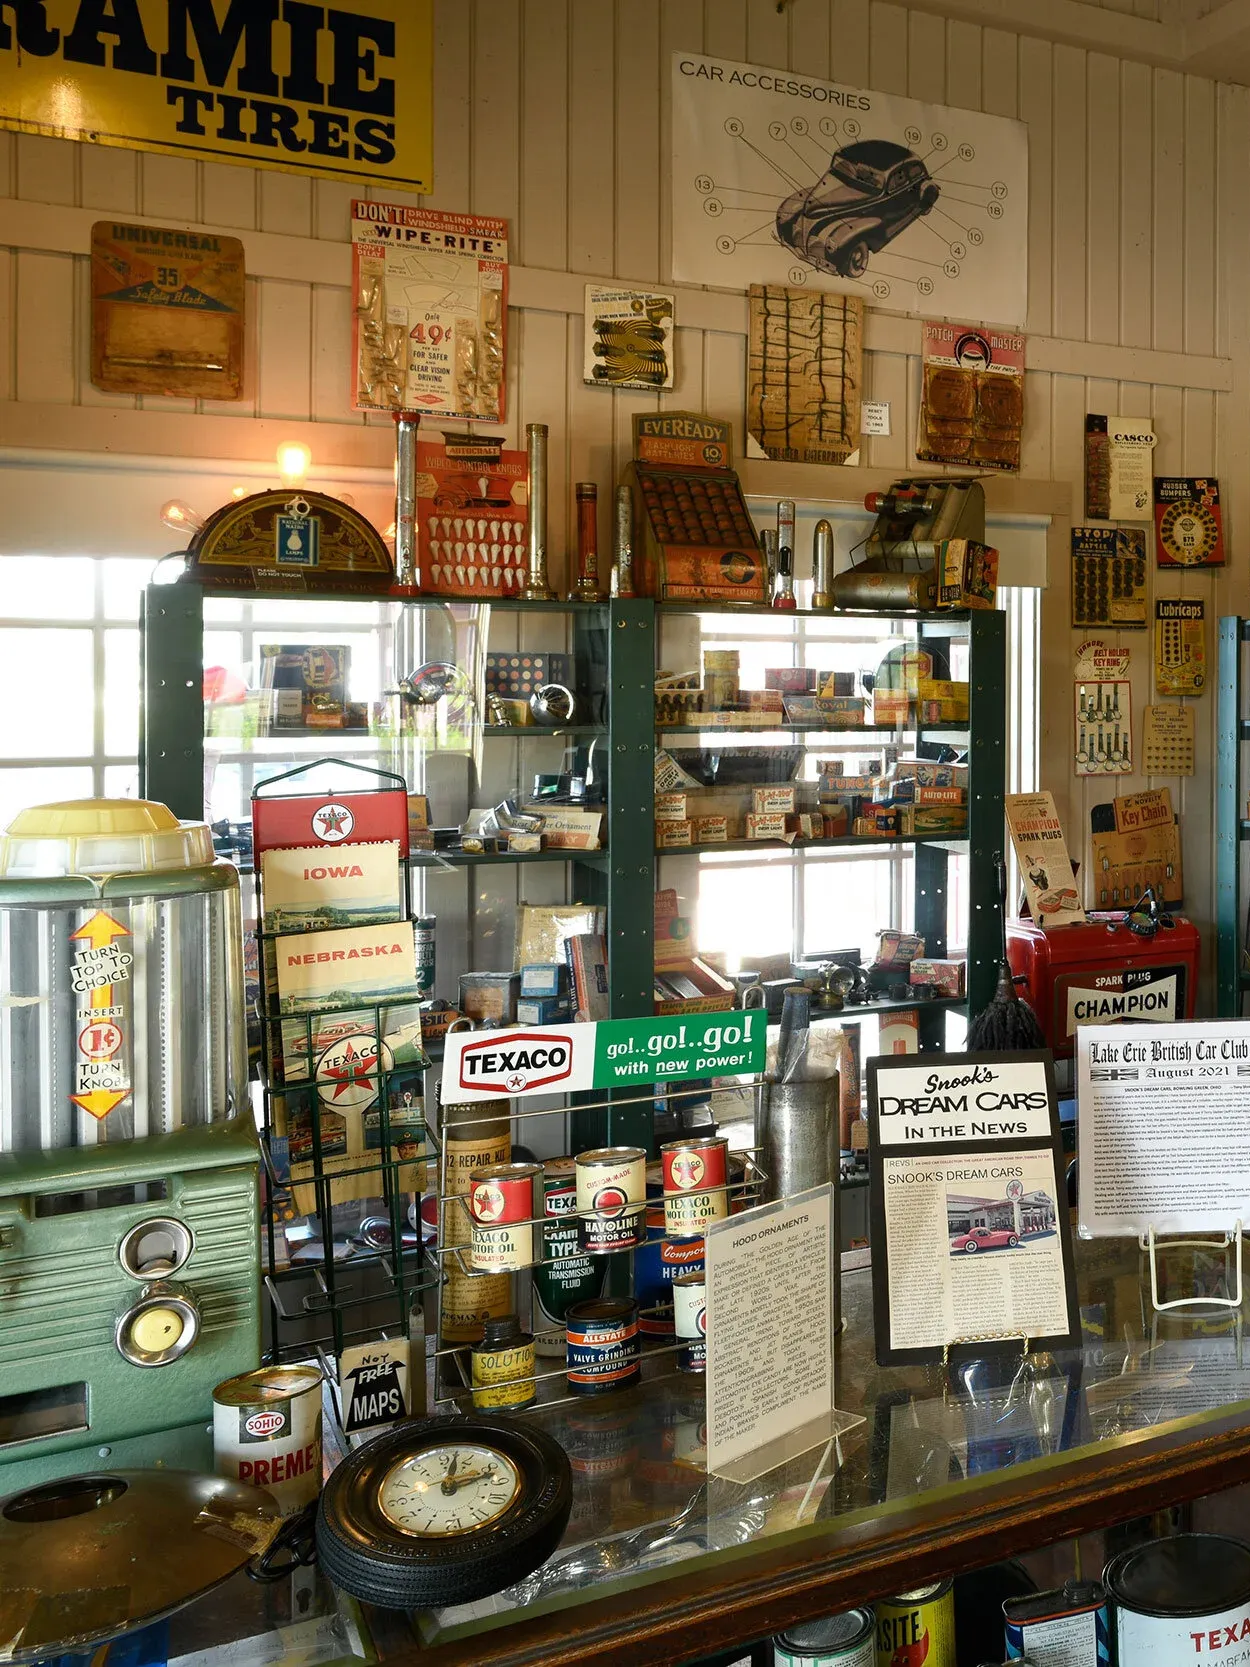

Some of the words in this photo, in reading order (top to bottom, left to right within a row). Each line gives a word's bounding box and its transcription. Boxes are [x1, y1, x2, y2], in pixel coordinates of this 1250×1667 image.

[680, 61, 724, 82] CAR
[729, 71, 871, 111] ACCESSORIES
[167, 85, 396, 164] TIRES
[357, 202, 407, 224] DON'T!
[408, 209, 438, 221] DRIVE
[443, 215, 473, 226] BLIND
[476, 218, 503, 229] WITH
[408, 219, 466, 233] WINDSHIELD
[468, 228, 504, 239] SMEAR
[112, 224, 221, 252] UNIVERSAL
[375, 225, 494, 253] WIPE-RITE
[157, 267, 178, 287] 35
[926, 327, 954, 342] PATCH
[991, 336, 1022, 351] MASTER
[413, 350, 426, 359] FOR
[428, 352, 448, 361] SAFER
[409, 364, 430, 372] CLEAR
[431, 366, 450, 375] VISION
[417, 374, 442, 383] DRIVING
[643, 419, 724, 440] EVEREADY
[1114, 433, 1154, 443] CASCO
[457, 461, 491, 473] CONTROL
[496, 464, 522, 475] KNOBS
[1159, 602, 1202, 619] Lubricaps
[1093, 658, 1105, 667] KEY
[1107, 658, 1121, 667] RING
[924, 791, 957, 799] AUTO-LITE
[1122, 811, 1139, 827] Key
[1142, 804, 1168, 822] Chain
[1015, 818, 1060, 832] CHAMPION
[1018, 832, 1041, 842] SPARK
[1041, 830, 1062, 840] PLUGS
[304, 864, 363, 881] IOWA
[79, 946, 119, 964] TURN
[288, 943, 403, 966] NEBRASKA
[74, 962, 103, 979] TOP
[110, 954, 131, 967] TO
[75, 969, 128, 992] CHOICE
[1095, 975, 1123, 987] SPARK
[1127, 972, 1151, 983] PLUG
[79, 1006, 122, 1018] INSERT
[1074, 991, 1169, 1019] CHAMPION
[324, 1045, 379, 1068] TEXACO
[1090, 1041, 1119, 1064] Lake
[1122, 1042, 1147, 1063] Erie
[1150, 1039, 1192, 1064] British
[1195, 1040, 1217, 1061] Car
[1220, 1038, 1249, 1060] Club
[80, 1063, 121, 1075] TURN
[465, 1047, 566, 1075] TEXACO
[614, 1061, 648, 1076] with
[656, 1058, 688, 1074] new
[924, 1066, 999, 1094] Snook's
[1145, 1067, 1194, 1080] August
[1198, 1066, 1229, 1077] 2021
[880, 1094, 968, 1117] DREAM
[976, 1091, 1047, 1111] CARS
[929, 1125, 966, 1137] THE
[889, 1159, 911, 1168] REVS
[888, 1171, 943, 1184] SNOOK'S
[946, 1169, 988, 1181] DREAM
[991, 1167, 1023, 1178] CARS
[670, 1197, 710, 1209] TEXACO
[667, 1209, 697, 1219] MOTOR
[701, 1207, 717, 1217] OIL
[585, 1217, 638, 1232] HAVOLINE
[732, 1232, 757, 1249] HOOD
[758, 1214, 809, 1242] ORNAMENTS
[590, 1233, 618, 1241] MOTOR
[621, 1230, 634, 1239] OIL
[552, 1258, 590, 1269] AUTOMATIC
[730, 1268, 757, 1281] INTRICATE
[765, 1258, 781, 1267] PIECE
[803, 1241, 826, 1253] ARTISTIC
[548, 1267, 595, 1280] TRANSMISSION
[562, 1279, 581, 1289] FLUID
[583, 1330, 626, 1343] ALLSTATE
[359, 1362, 394, 1384] FREE
[354, 1391, 400, 1423] MAPS
[248, 1416, 283, 1433] SOHIO
